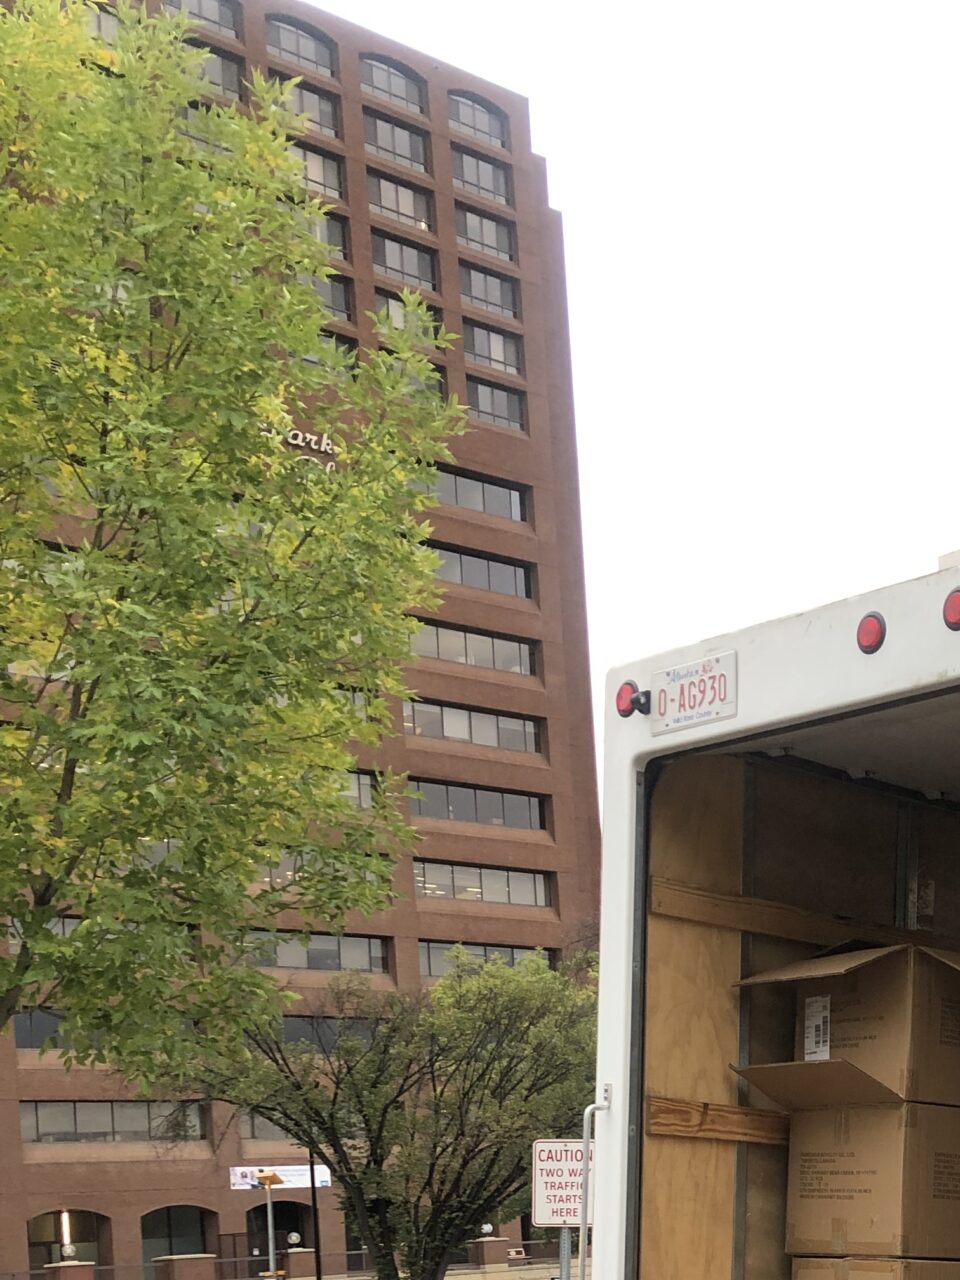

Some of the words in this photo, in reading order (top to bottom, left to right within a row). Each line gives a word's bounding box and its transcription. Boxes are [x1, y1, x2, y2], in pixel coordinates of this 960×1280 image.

[539, 1168, 564, 1177] TWO
[546, 1194, 583, 1204] STARTS
[551, 1207, 579, 1217] HERE
